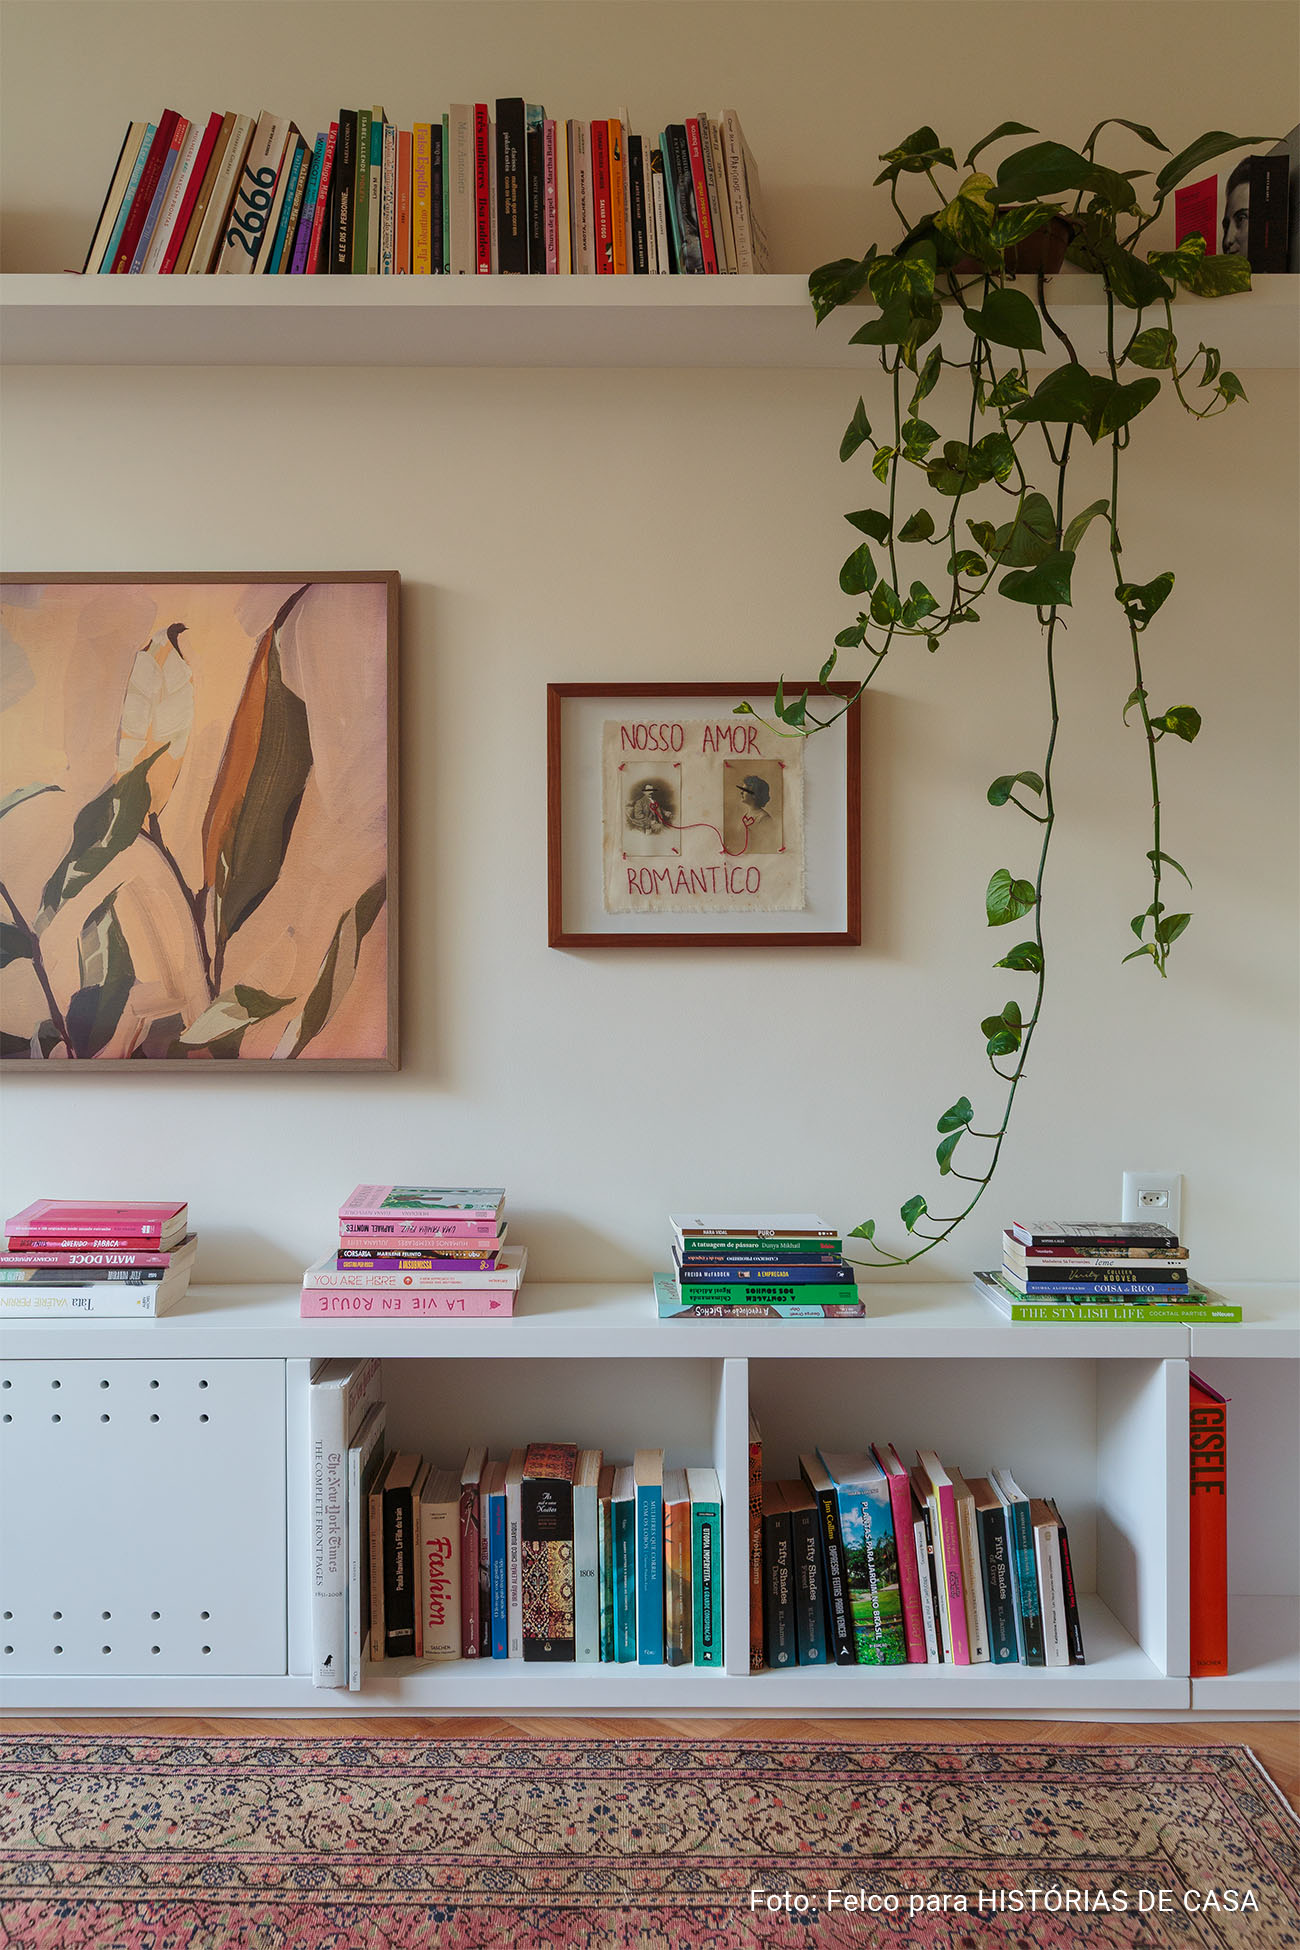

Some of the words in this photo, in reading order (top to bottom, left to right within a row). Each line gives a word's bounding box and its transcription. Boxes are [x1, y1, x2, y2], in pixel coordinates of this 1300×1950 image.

[477, 111, 485, 132] três
[326, 129, 336, 158] Valter
[416, 128, 427, 154] Falso
[689, 124, 698, 145] barros
[309, 136, 324, 186] WINNICOTT
[321, 161, 330, 181] Hugo
[477, 136, 487, 188] mulheres
[415, 156, 428, 197] Espelho
[728, 155, 742, 193] PARISIENSE
[226, 165, 277, 259] 2666
[698, 196, 706, 214] nasci
[417, 209, 427, 245] Tolentino
[548, 219, 553, 227] de
[479, 220, 487, 256] taddeo
[620, 723, 684, 752] NOSSO
[702, 725, 761, 755] AMOR
[626, 862, 760, 895] ROMÂNTICO
[346, 1224, 372, 1232] MONTES
[446, 1225, 456, 1234] UMA
[61, 1239, 88, 1248] QUERIDO
[93, 1239, 119, 1248] BABACA
[69, 1255, 100, 1264] DOCE
[102, 1255, 135, 1264] MATA
[314, 1275, 338, 1285] YOU
[340, 1275, 363, 1285] ARE
[366, 1275, 396, 1286] HERE
[1069, 1269, 1100, 1280] Verity
[1103, 1274, 1137, 1282] HOOVER
[33, 1299, 68, 1310] VALÉRIE
[72, 1298, 94, 1311] Tata
[319, 1297, 372, 1311] ROUJE
[382, 1299, 401, 1309] EN
[447, 1299, 465, 1311] LA
[1020, 1308, 1047, 1318] THE
[1052, 1308, 1109, 1318] STYLISH
[1114, 1308, 1144, 1318] LIFE
[314, 1439, 322, 1460] THE
[1191, 1408, 1225, 1496] GISELE
[327, 1453, 340, 1474] The
[314, 1462, 323, 1517] COMPLETE
[327, 1476, 340, 1502] New
[822, 1499, 832, 1513] Jim
[325, 1505, 341, 1534] York
[395, 1520, 402, 1528] du
[643, 1517, 648, 1526] OS
[825, 1513, 835, 1539] Collins
[861, 1501, 872, 1539] PLANTAS
[315, 1518, 323, 1555] FRONT
[992, 1535, 1004, 1561] Fifty
[328, 1536, 341, 1572] Times
[776, 1540, 787, 1565] Fifty
[805, 1537, 815, 1562] Fifty
[828, 1545, 839, 1576] EMPRESAS
[865, 1540, 874, 1562] PARA
[988, 1554, 995, 1563] of
[315, 1556, 323, 1586] PAGES
[702, 1549, 710, 1581] IMPERFEITA
[988, 1564, 998, 1585] Grey
[426, 1536, 453, 1628] Fashion
[771, 1565, 779, 1595] Darker
[779, 1568, 789, 1604] Shades
[807, 1564, 818, 1600] Shades
[831, 1576, 842, 1597] FEITAS
[868, 1563, 879, 1595] JARDIM
[995, 1563, 1009, 1599] Shades
[834, 1597, 844, 1614] PARA
[871, 1596, 879, 1609] NO
[905, 1593, 919, 1609] In
[836, 1615, 846, 1638] VENCER
[873, 1610, 883, 1640] BRASIL
[907, 1612, 923, 1646] Lean
[998, 1617, 1007, 1641] James
